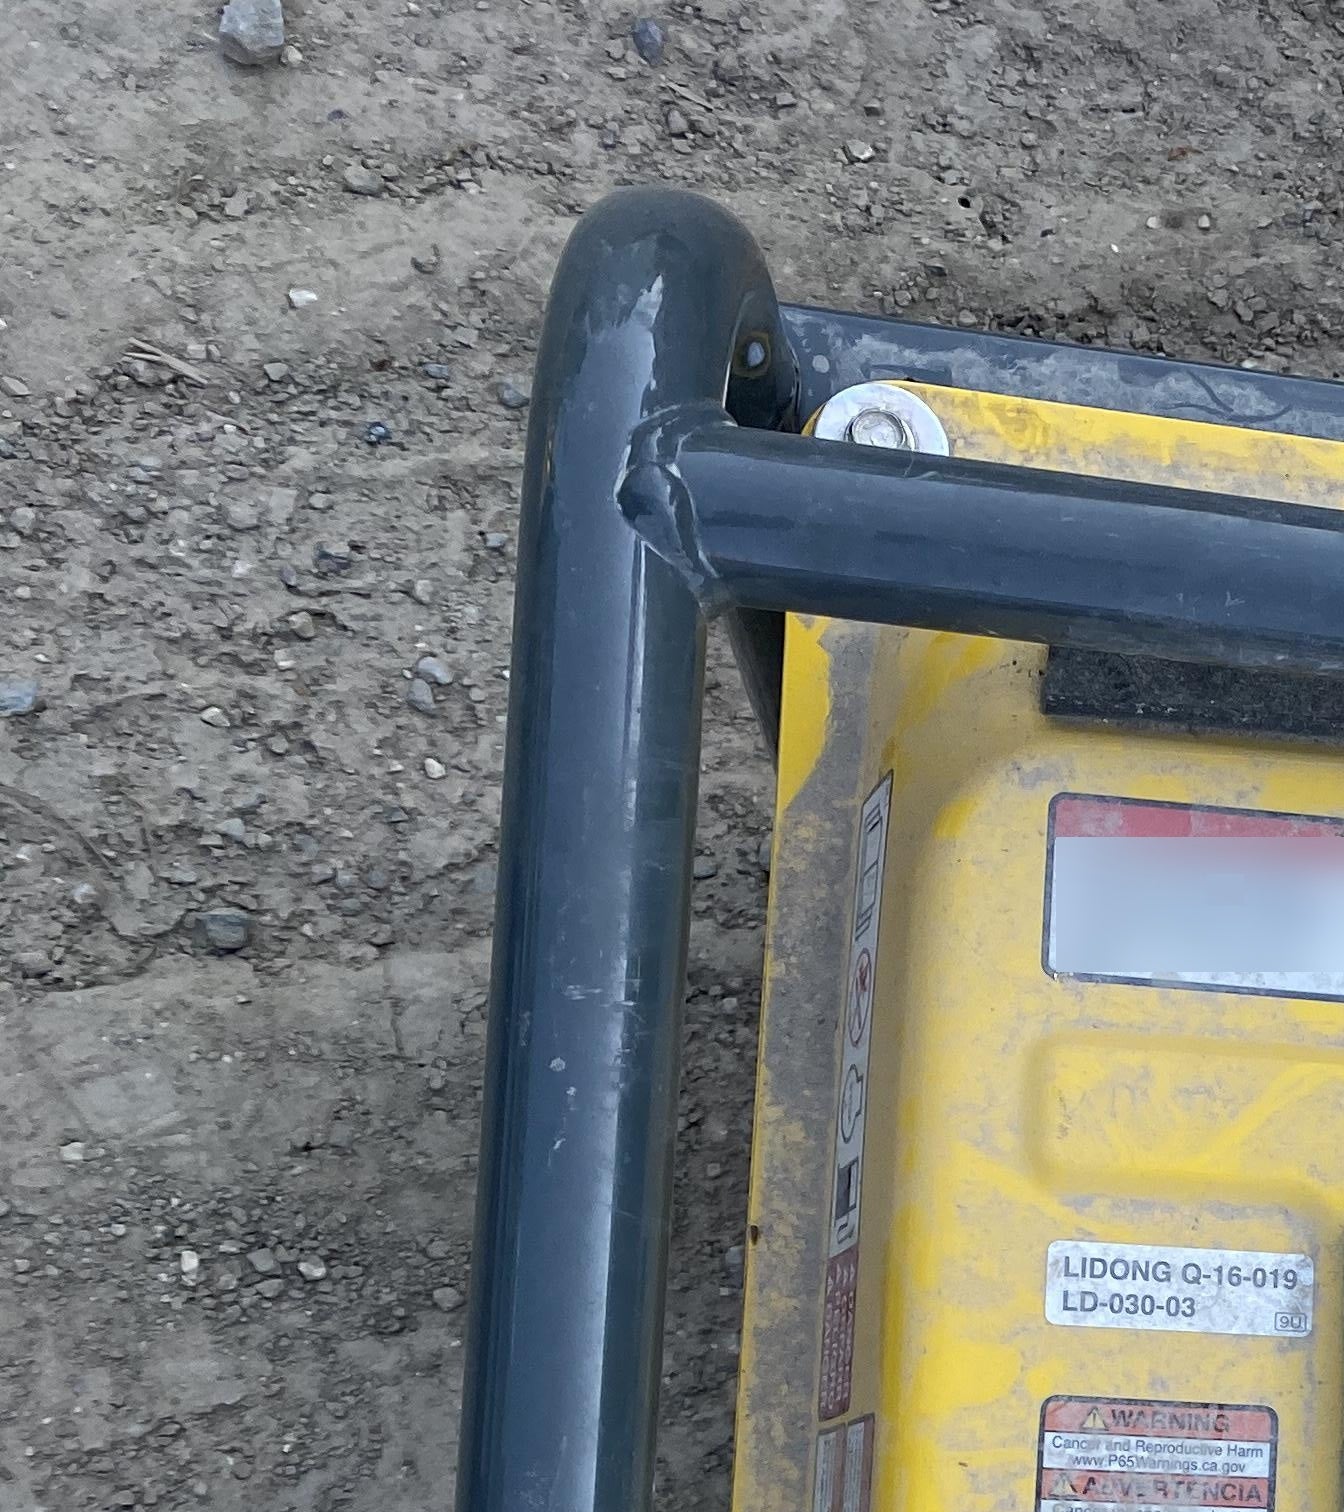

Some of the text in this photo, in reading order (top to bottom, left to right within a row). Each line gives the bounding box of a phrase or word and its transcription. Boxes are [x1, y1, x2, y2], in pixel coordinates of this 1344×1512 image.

[1063, 1256, 1298, 1290] LIDONG Q-16-019
[1062, 1290, 1196, 1318] LD-030-03
[1279, 1315, 1302, 1329] 9U
[1111, 1408, 1230, 1433] WARNING
[1105, 1439, 1130, 1452] and
[1136, 1439, 1223, 1457] Reproductive
[1226, 1444, 1264, 1458] Harm
